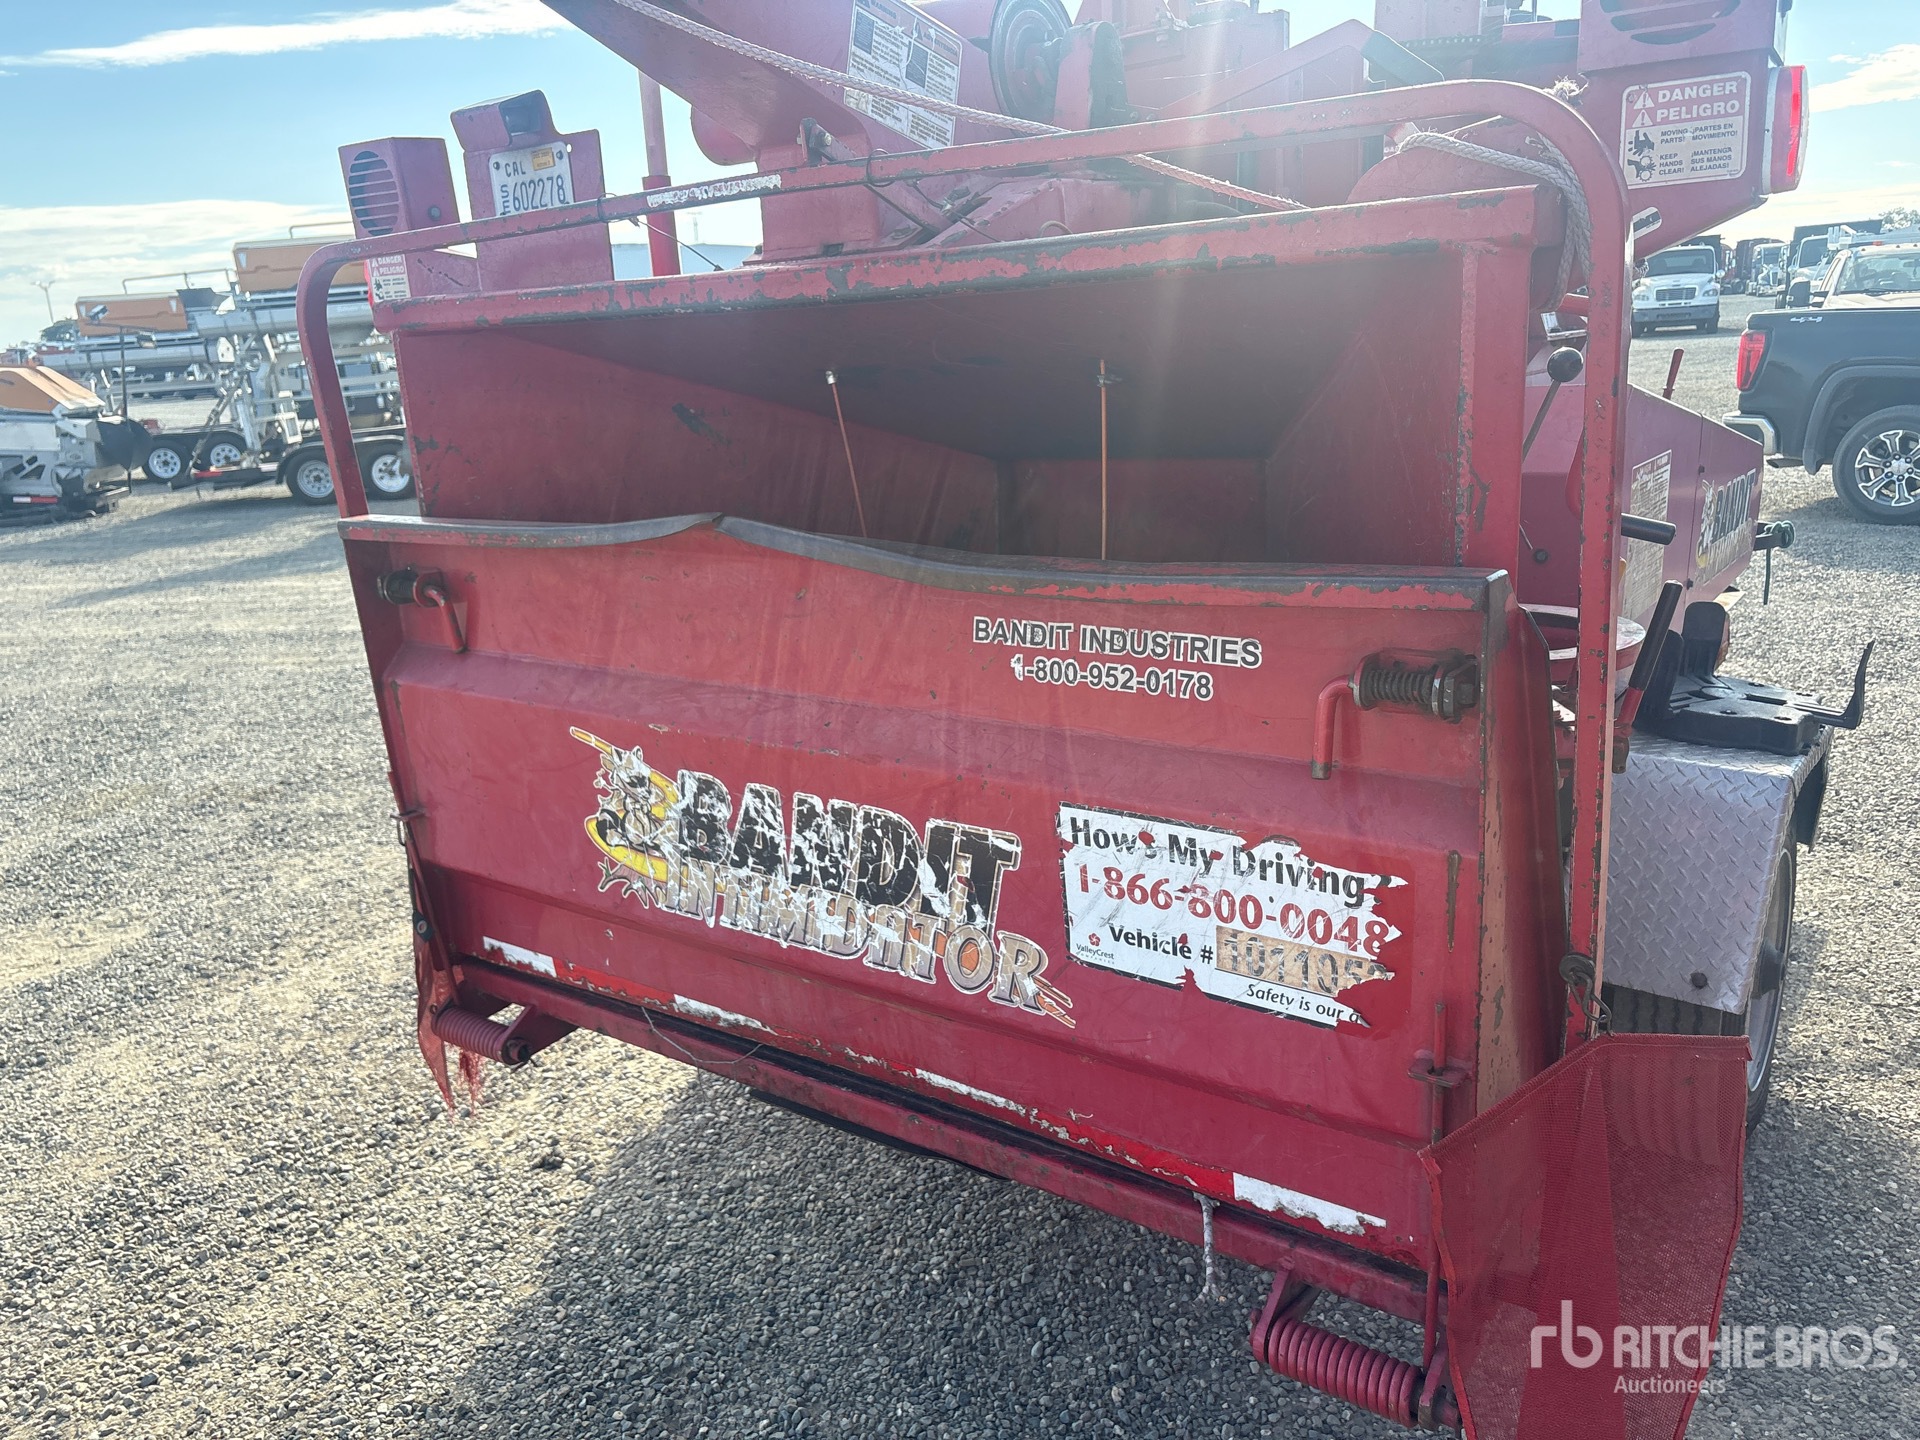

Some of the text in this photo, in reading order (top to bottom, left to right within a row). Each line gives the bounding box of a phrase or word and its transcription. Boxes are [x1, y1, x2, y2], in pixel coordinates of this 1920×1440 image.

[1658, 81, 1737, 103] DANGER
[1657, 100, 1740, 122] PELIGRO
[1660, 136, 1685, 144] PARTS!
[1661, 128, 1688, 137] MOVING
[1692, 130, 1738, 140] MOVIMIENTO!
[504, 161, 526, 177] CAL
[1659, 160, 1683, 168] HANDS
[1690, 162, 1729, 172] ALEJADAS!
[1706, 154, 1732, 163] MANOS
[512, 174, 566, 212] 602278
[973, 616, 1263, 669] BANDIT INDUSTRIES
[1010, 654, 1214, 701] 1-800-952-0178
[676, 769, 1022, 934] BANDIT
[1168, 833, 1219, 877] My
[1078, 863, 1389, 957] 1-866-800-0048
[1076, 943, 1114, 960] ValleyCrest
[1108, 923, 1192, 960] Vehicle
[1200, 945, 1213, 964] #
[1246, 983, 1294, 1011] Safety
[1299, 996, 1310, 1012] is
[1315, 1003, 1344, 1021] our
